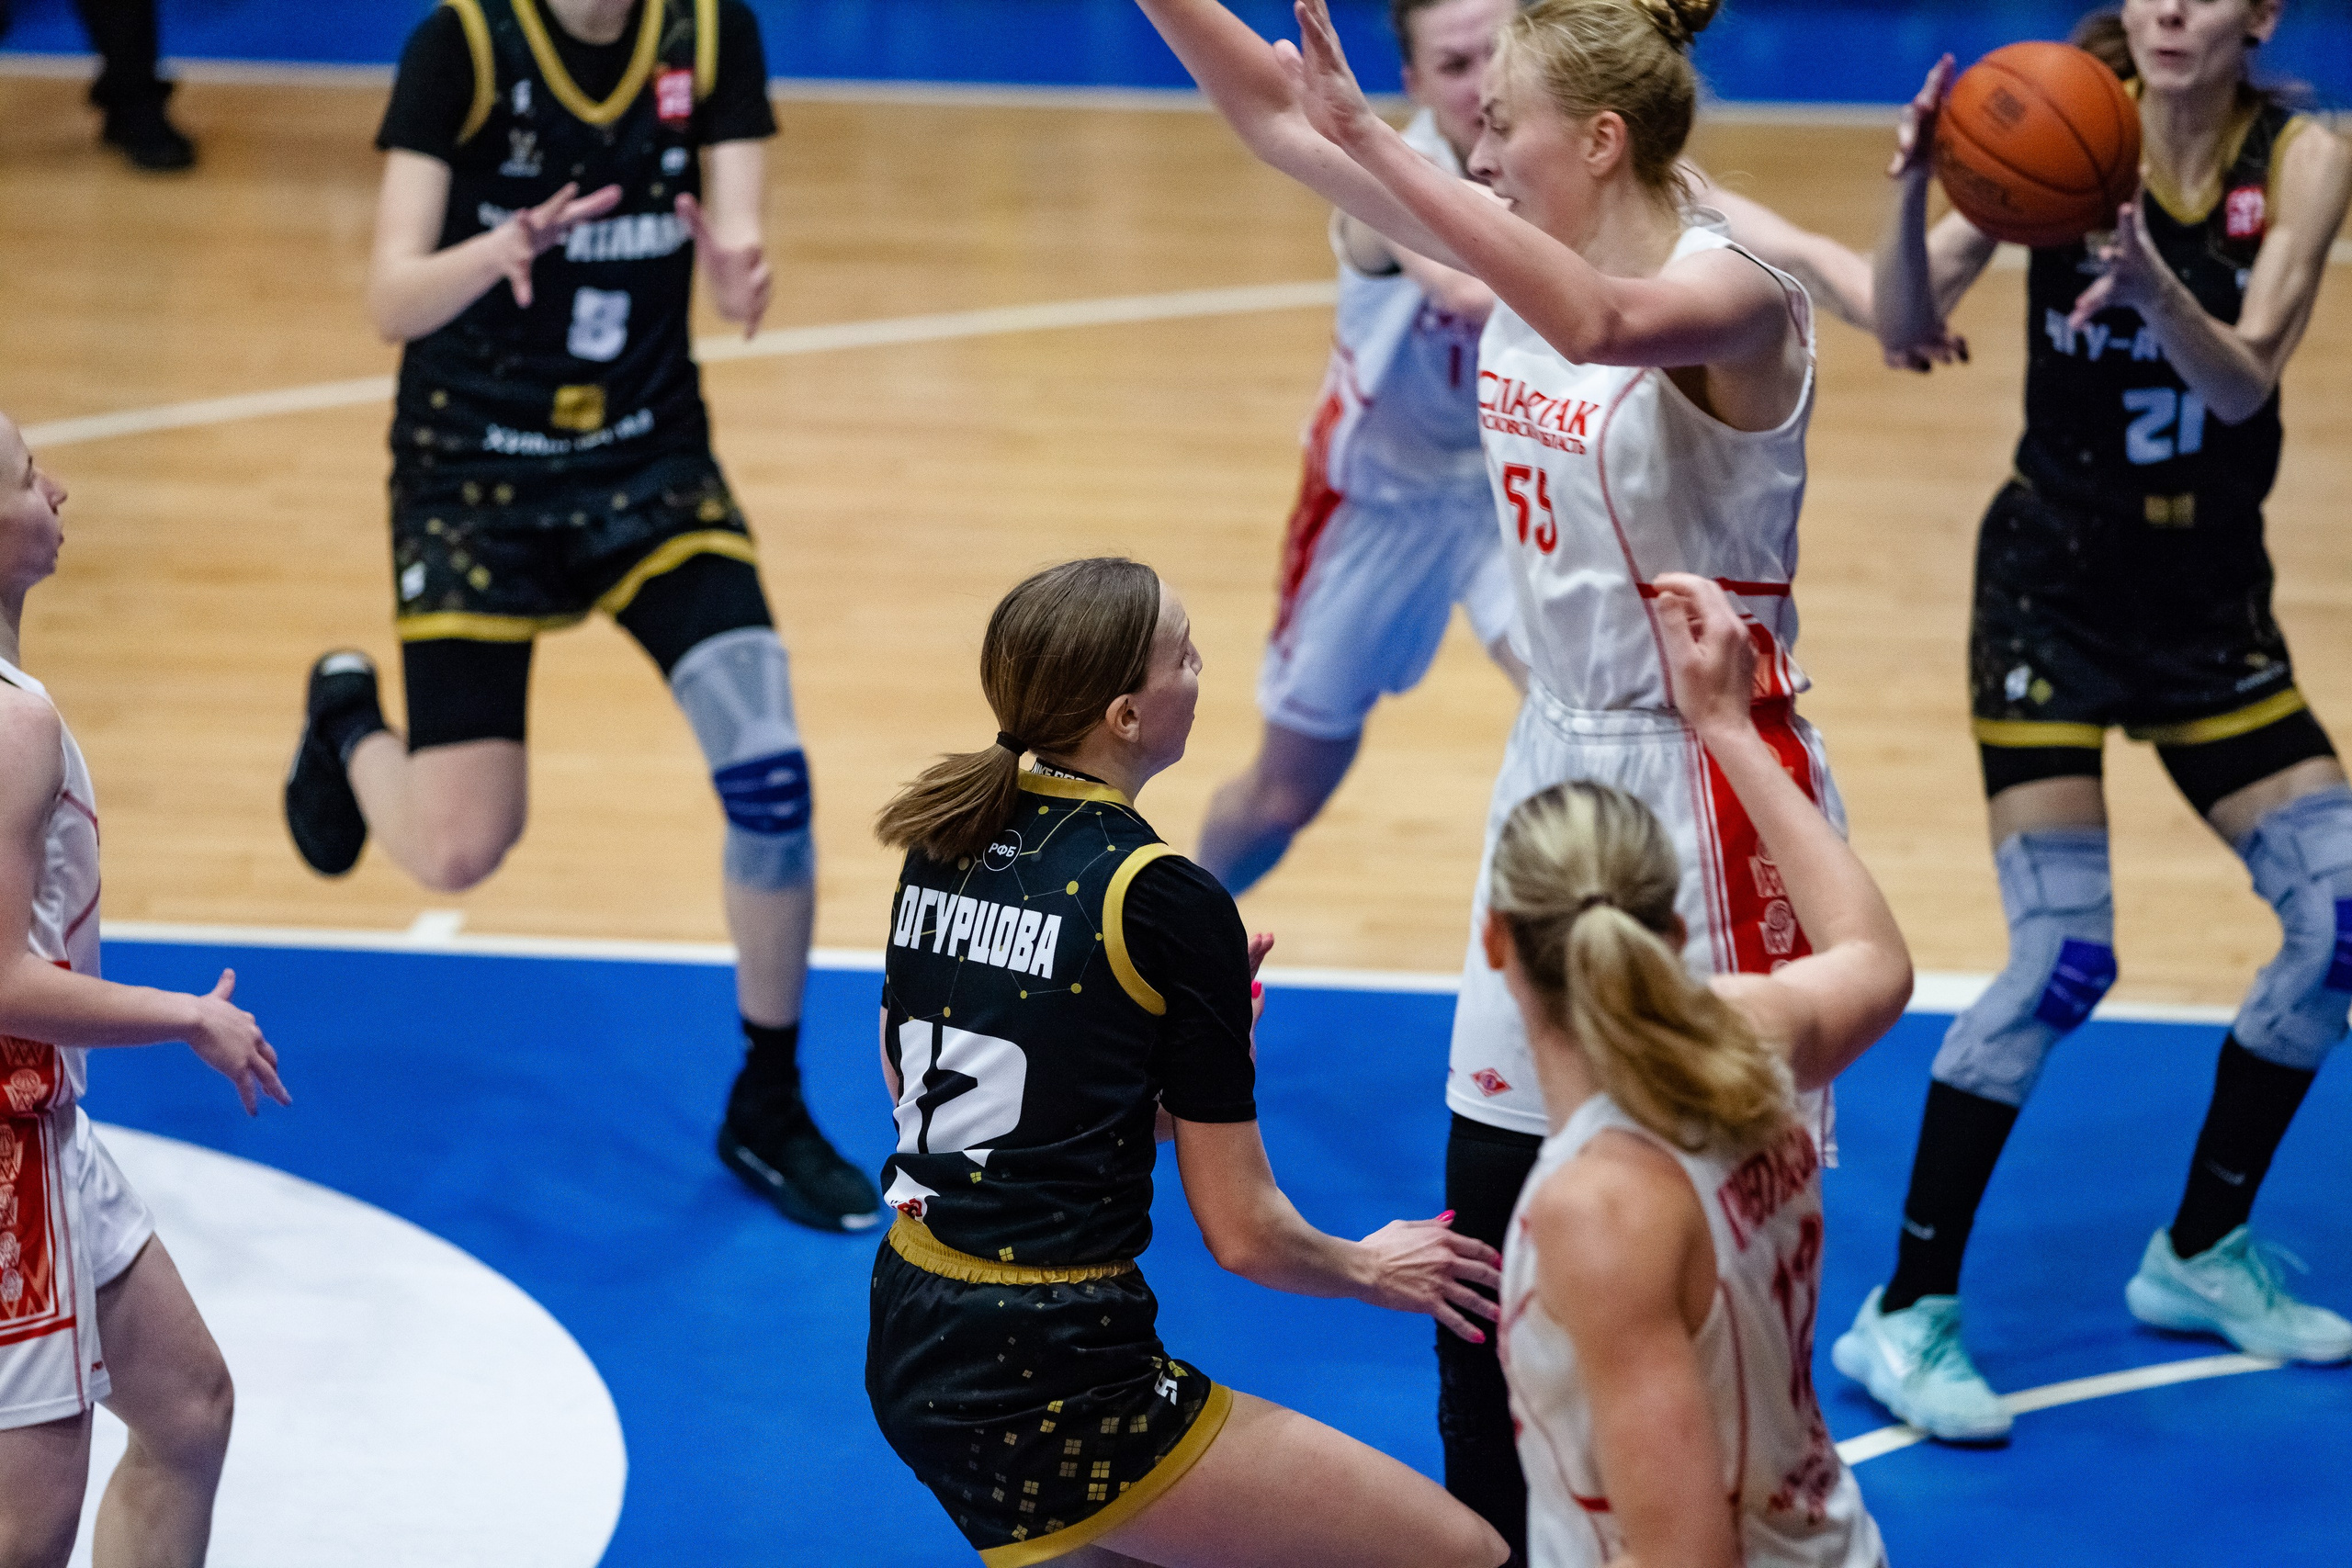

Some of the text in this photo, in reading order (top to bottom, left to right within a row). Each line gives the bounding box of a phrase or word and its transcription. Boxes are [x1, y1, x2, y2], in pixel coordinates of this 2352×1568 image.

[2122, 387, 2206, 466] 21
[1502, 461, 1558, 556] 55
[988, 841, 1017, 858] РФБ
[893, 885, 1062, 980] ОГУРЦОВА
[892, 1019, 1027, 1168] 12
